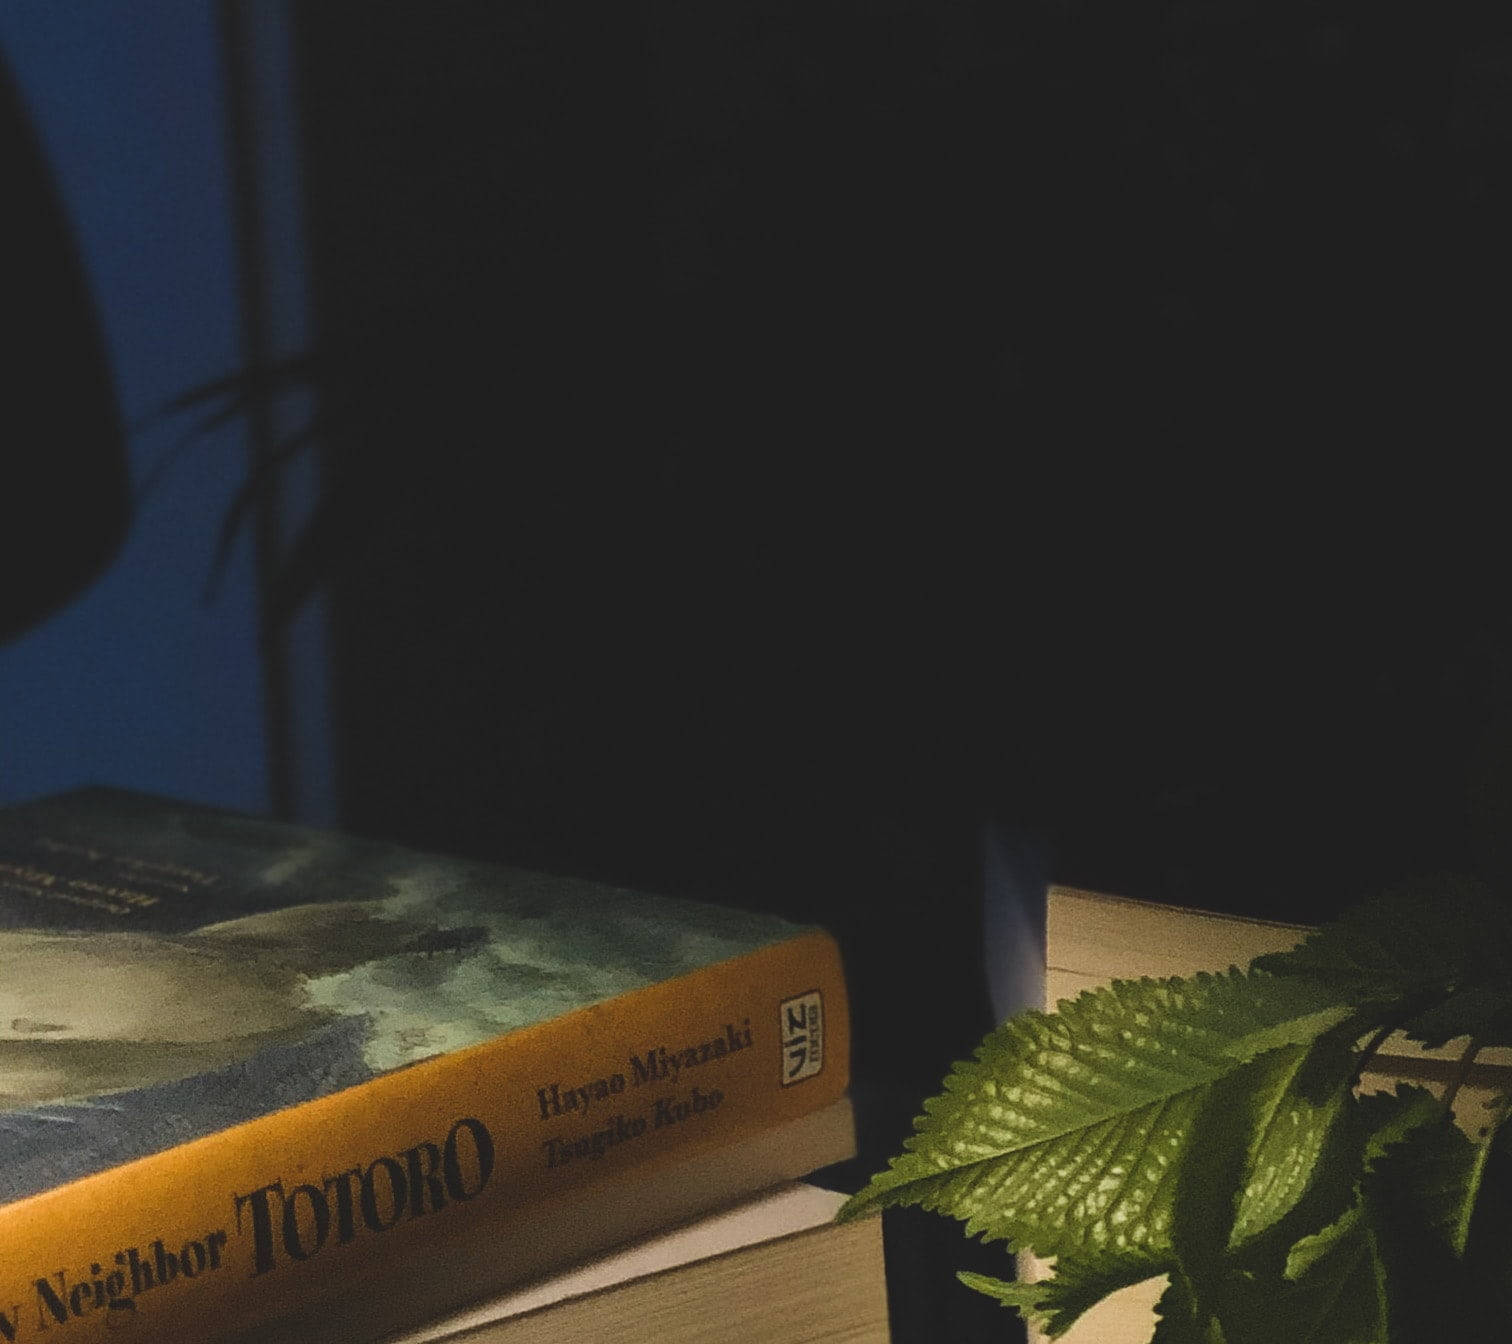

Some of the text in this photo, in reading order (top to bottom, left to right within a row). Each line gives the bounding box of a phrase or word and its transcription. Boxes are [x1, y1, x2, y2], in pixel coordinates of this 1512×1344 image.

[536, 1071, 627, 1121] Hayao
[629, 1017, 754, 1089] Miyazaki
[652, 1085, 726, 1129] Kubo
[32, 1229, 228, 1334] Neighbor
[232, 1117, 495, 1276] TOTORO
